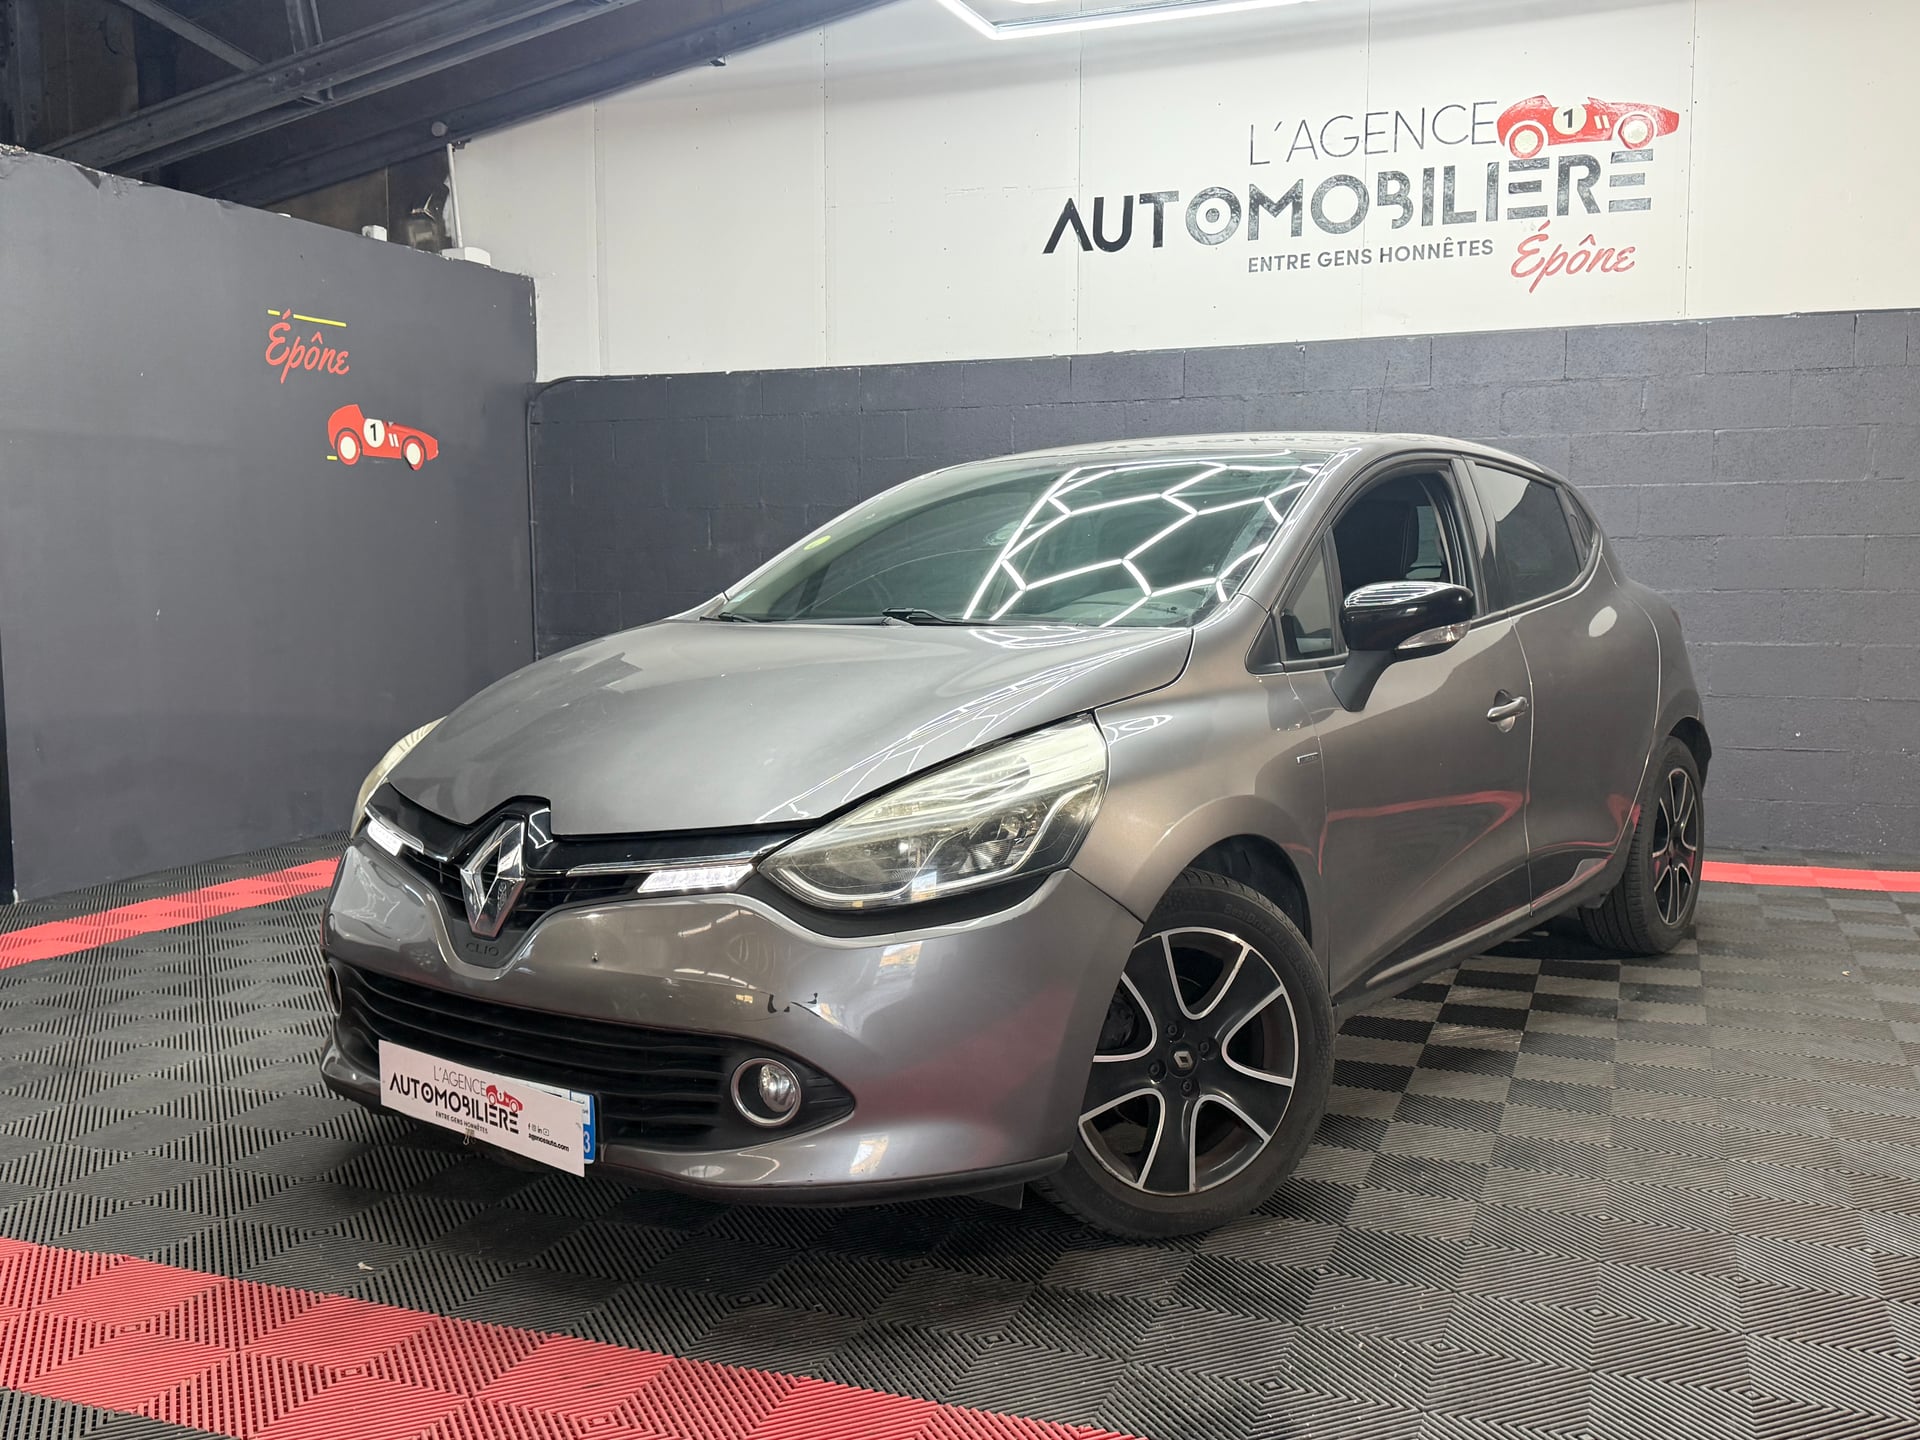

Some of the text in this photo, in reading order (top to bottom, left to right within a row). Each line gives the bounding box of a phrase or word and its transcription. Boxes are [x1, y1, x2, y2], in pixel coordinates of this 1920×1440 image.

[1249, 100, 1498, 166] L'AGENCE
[1248, 236, 1494, 273] ENTRE GENS HONNÊTES
[1510, 219, 1636, 294] Épône
[265, 308, 350, 385] Épône
[465, 942, 500, 957] CLIO
[433, 1065, 487, 1097] L'AGENCE
[435, 1110, 450, 1122] ENTRE
[450, 1115, 464, 1126] GENS
